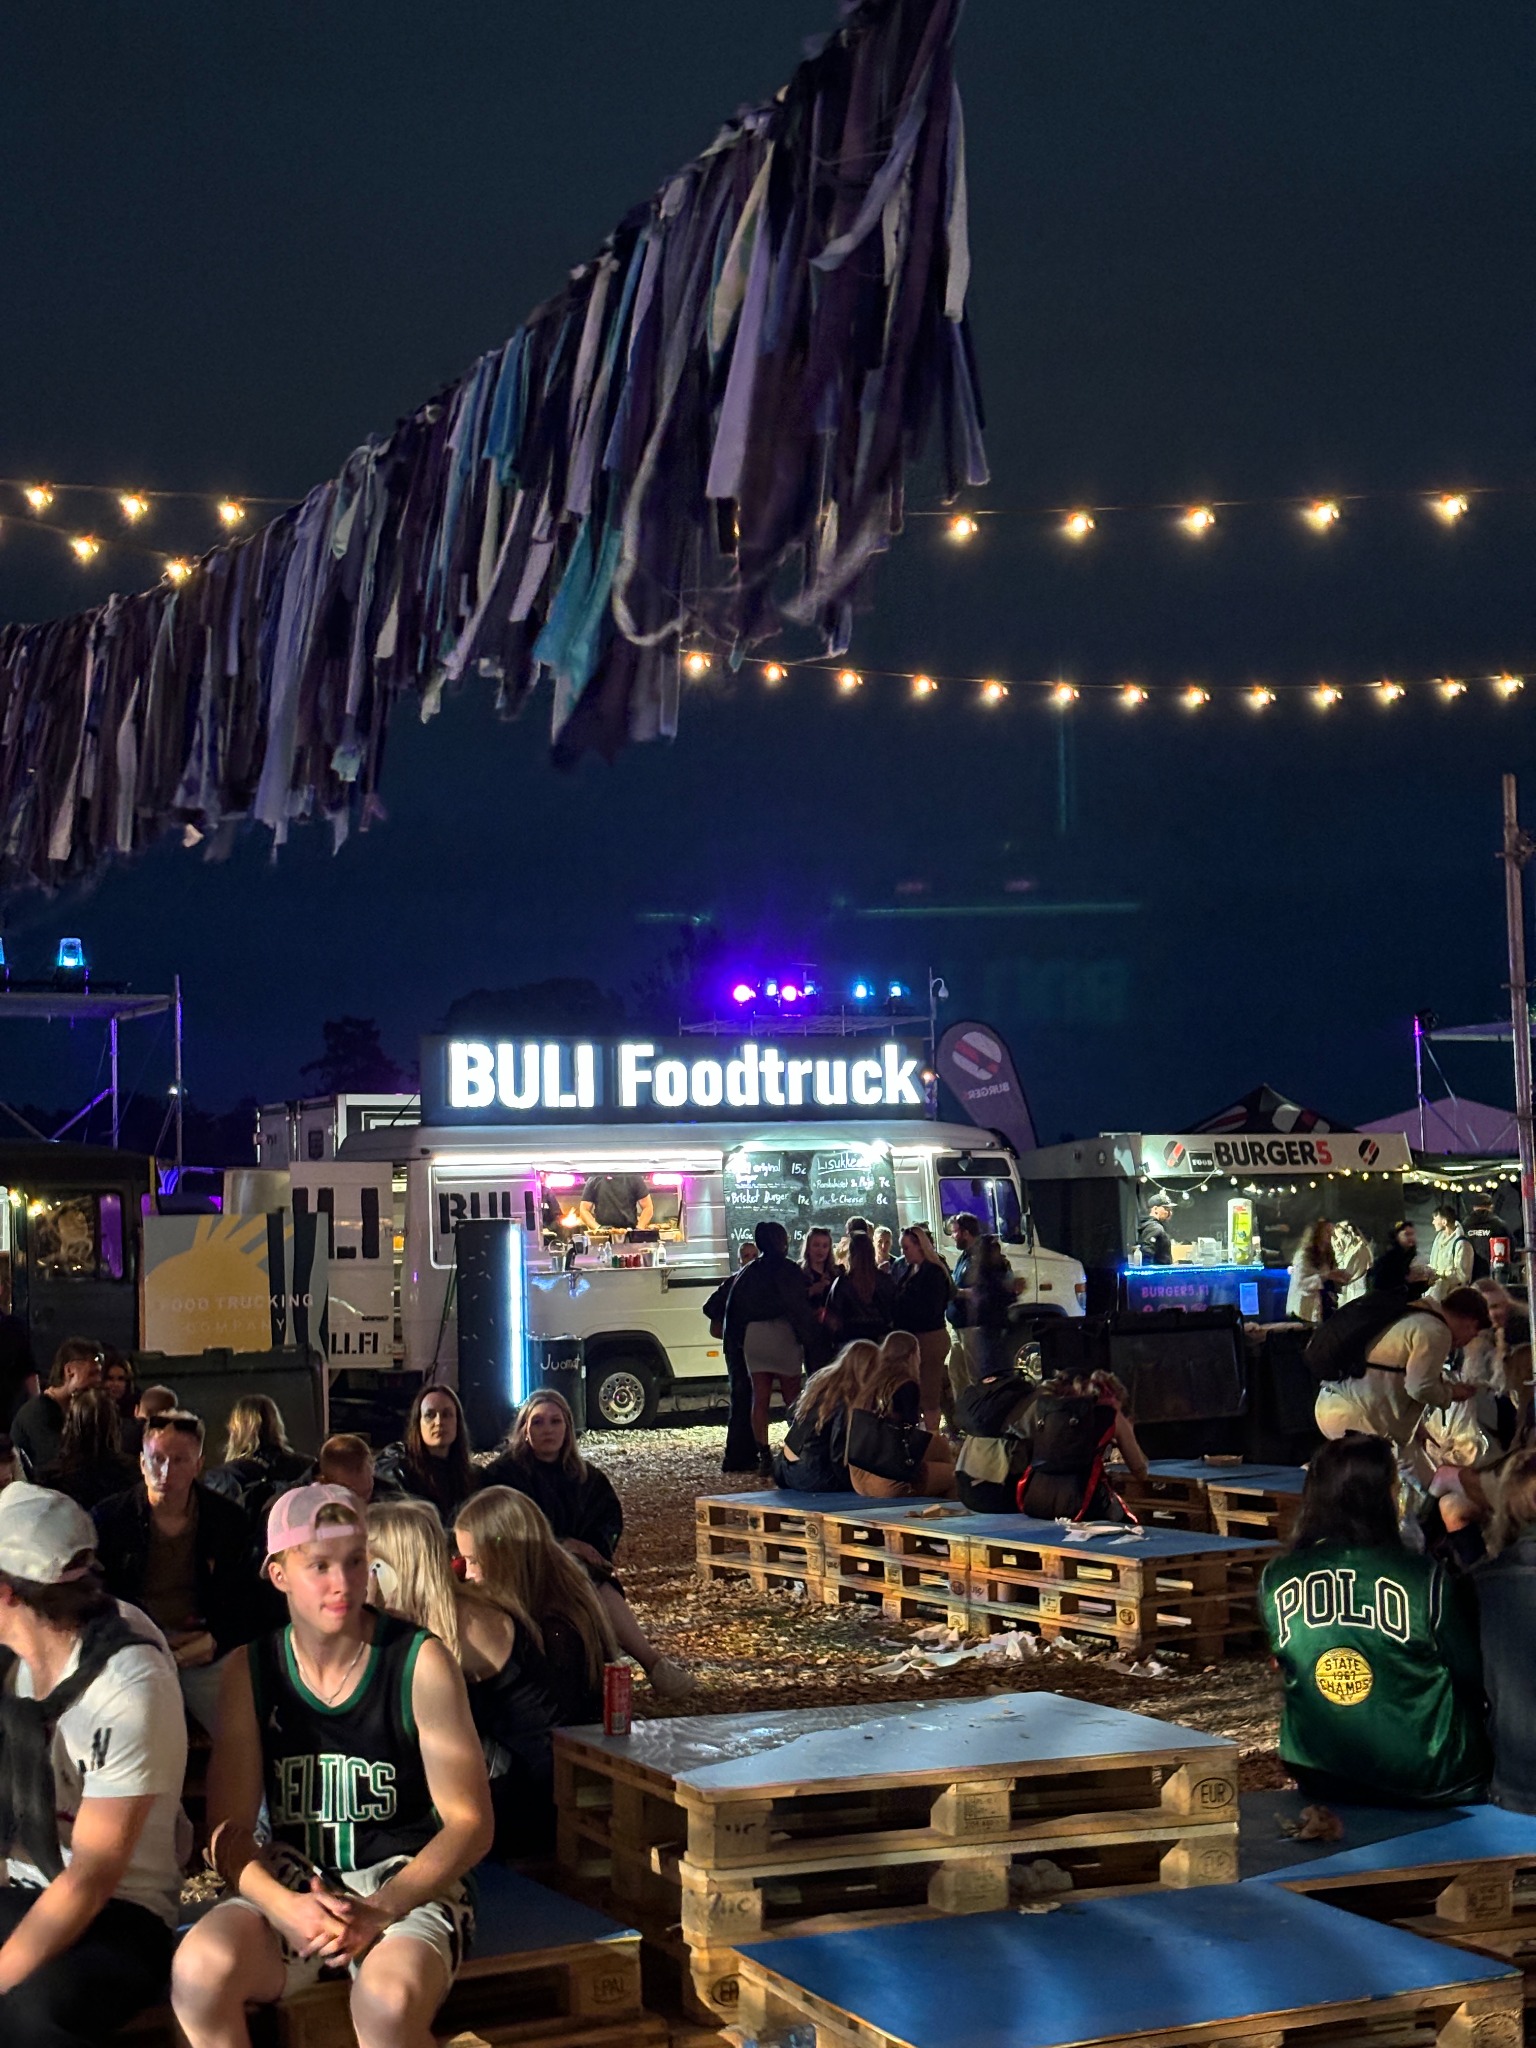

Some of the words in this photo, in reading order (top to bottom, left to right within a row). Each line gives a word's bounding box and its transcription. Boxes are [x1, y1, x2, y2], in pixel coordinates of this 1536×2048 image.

[449, 1042, 595, 1109] BULI
[619, 1043, 921, 1107] Foodtruck
[1214, 1140, 1333, 1167] BURGER5
[731, 1188, 760, 1205] Brisket
[1467, 1229, 1490, 1237] CREW
[217, 1293, 314, 1310] TRUCKING
[1273, 1568, 1411, 1649] POLO
[1324, 1657, 1361, 1672] STATE
[1319, 1678, 1369, 1696] CHAMPS
